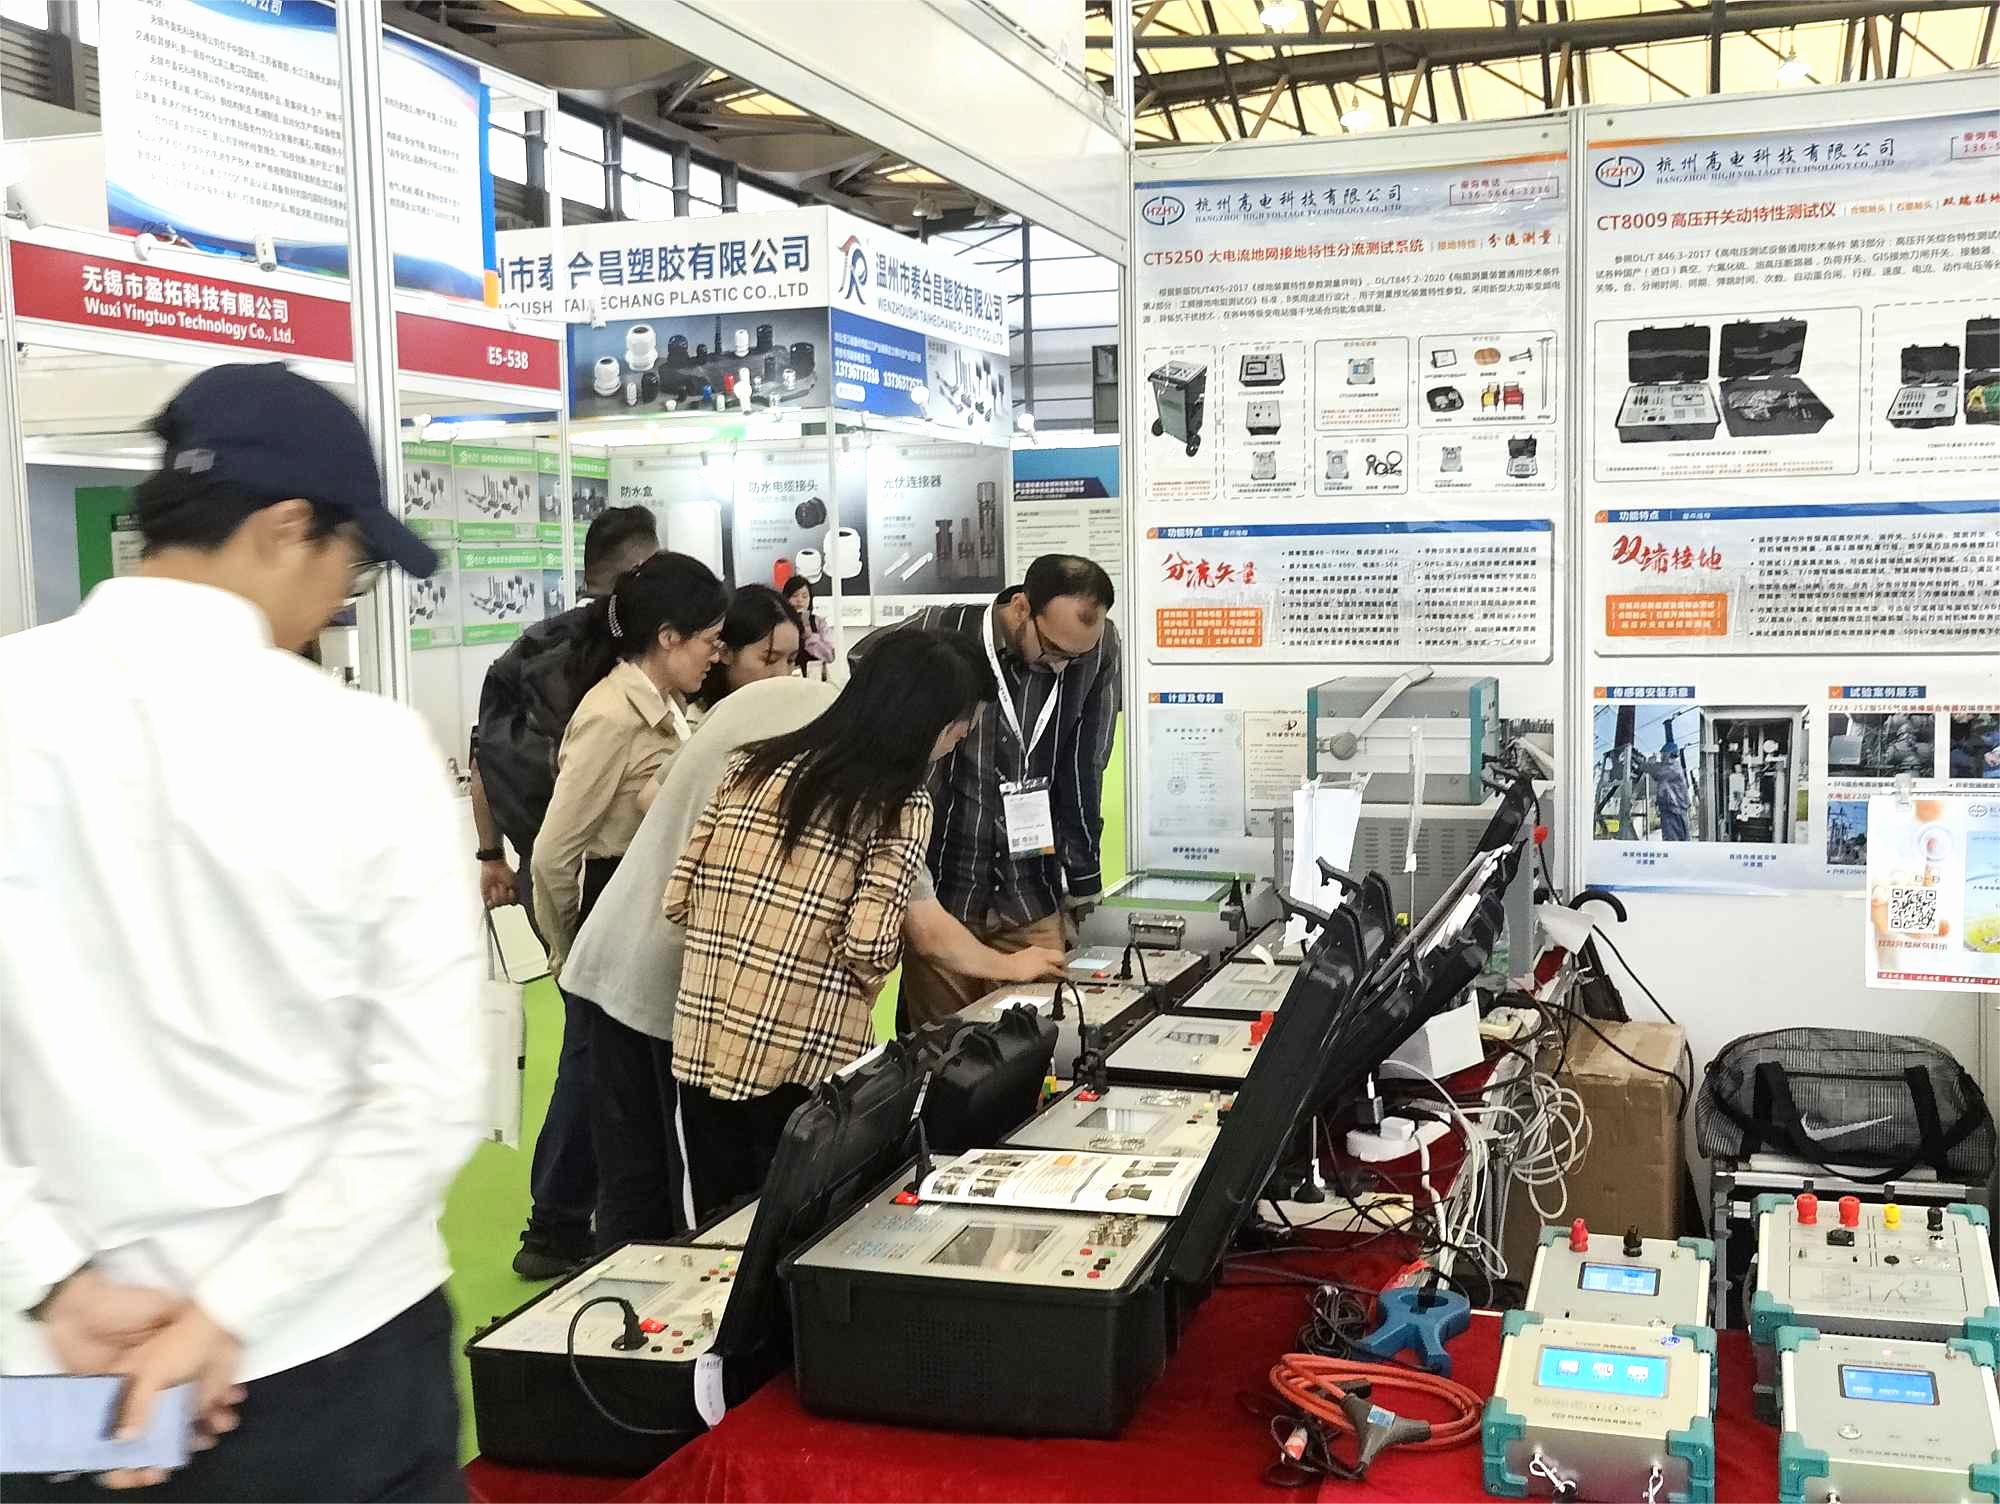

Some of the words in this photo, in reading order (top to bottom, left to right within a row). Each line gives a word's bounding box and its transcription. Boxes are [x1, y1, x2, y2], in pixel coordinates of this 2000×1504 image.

[1657, 138, 1895, 174] 杭州高电科技有限公司
[1195, 184, 1402, 212] 杭州高电科技有限公司
[1597, 212, 1668, 230] CT8009
[1671, 202, 1836, 228] 高压开关动特性测试仪
[497, 235, 810, 294] 市泰合昌塑胶有限公司
[1143, 250, 1204, 265] CT5250
[1209, 239, 1424, 263] 大电流地网接地特性分流测试系统
[82, 265, 289, 324] 无锡市盈拓科技有限公司
[670, 287, 738, 305] PLASTIC
[743, 282, 809, 301] CO.,LTD
[875, 252, 1004, 326] 温州市泰合昌塑胶有限公司
[84, 296, 121, 318] Wuxi
[122, 302, 177, 327] Yingtuo
[177, 311, 248, 341] Technology
[249, 323, 272, 342] Co.,
[273, 327, 296, 344] Ltd.
[486, 347, 529, 370] E5-538
[748, 479, 819, 494] 防水电缆接头
[884, 474, 944, 489] 光伏连接器
[1618, 510, 1660, 521] 功能特点
[1167, 527, 1203, 538] 功能特点
[1612, 535, 1722, 574] 双端接地
[1160, 551, 1257, 589] 分流矢量
[1168, 693, 1216, 703] 计量及专利
[1613, 686, 1689, 698] 传感器安装示意
[1850, 686, 1919, 698] 试验案例展示
